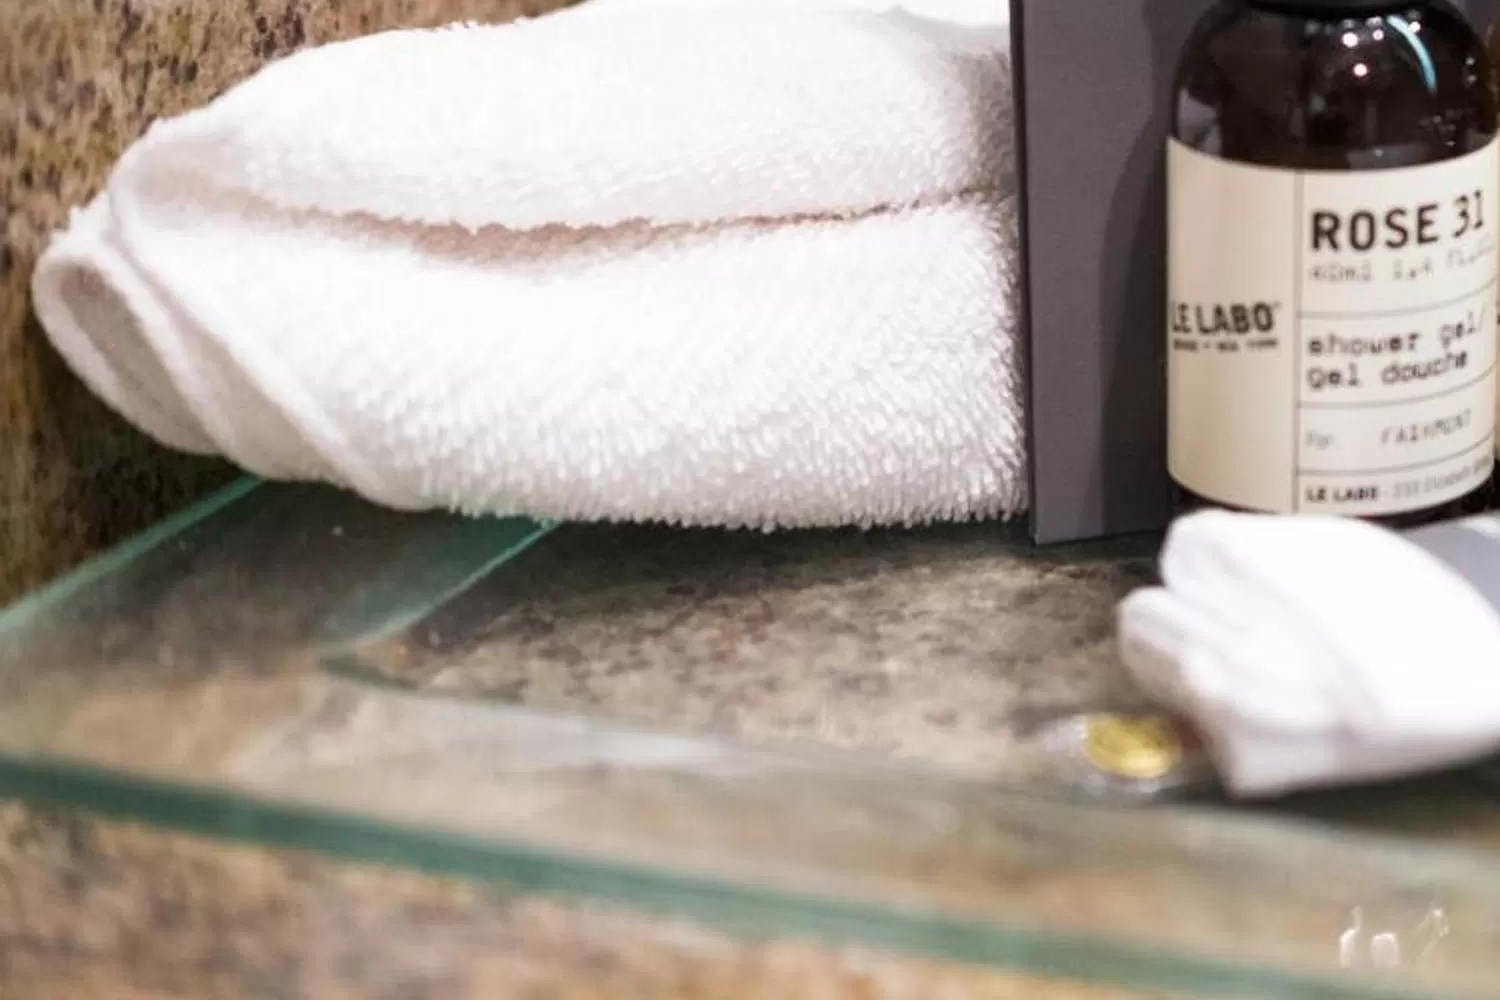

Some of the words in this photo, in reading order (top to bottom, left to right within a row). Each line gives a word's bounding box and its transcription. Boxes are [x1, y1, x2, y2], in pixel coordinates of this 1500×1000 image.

[1311, 203, 1440, 252] ROSE
[1453, 189, 1484, 238] 31
[1195, 301, 1274, 336] LABO
